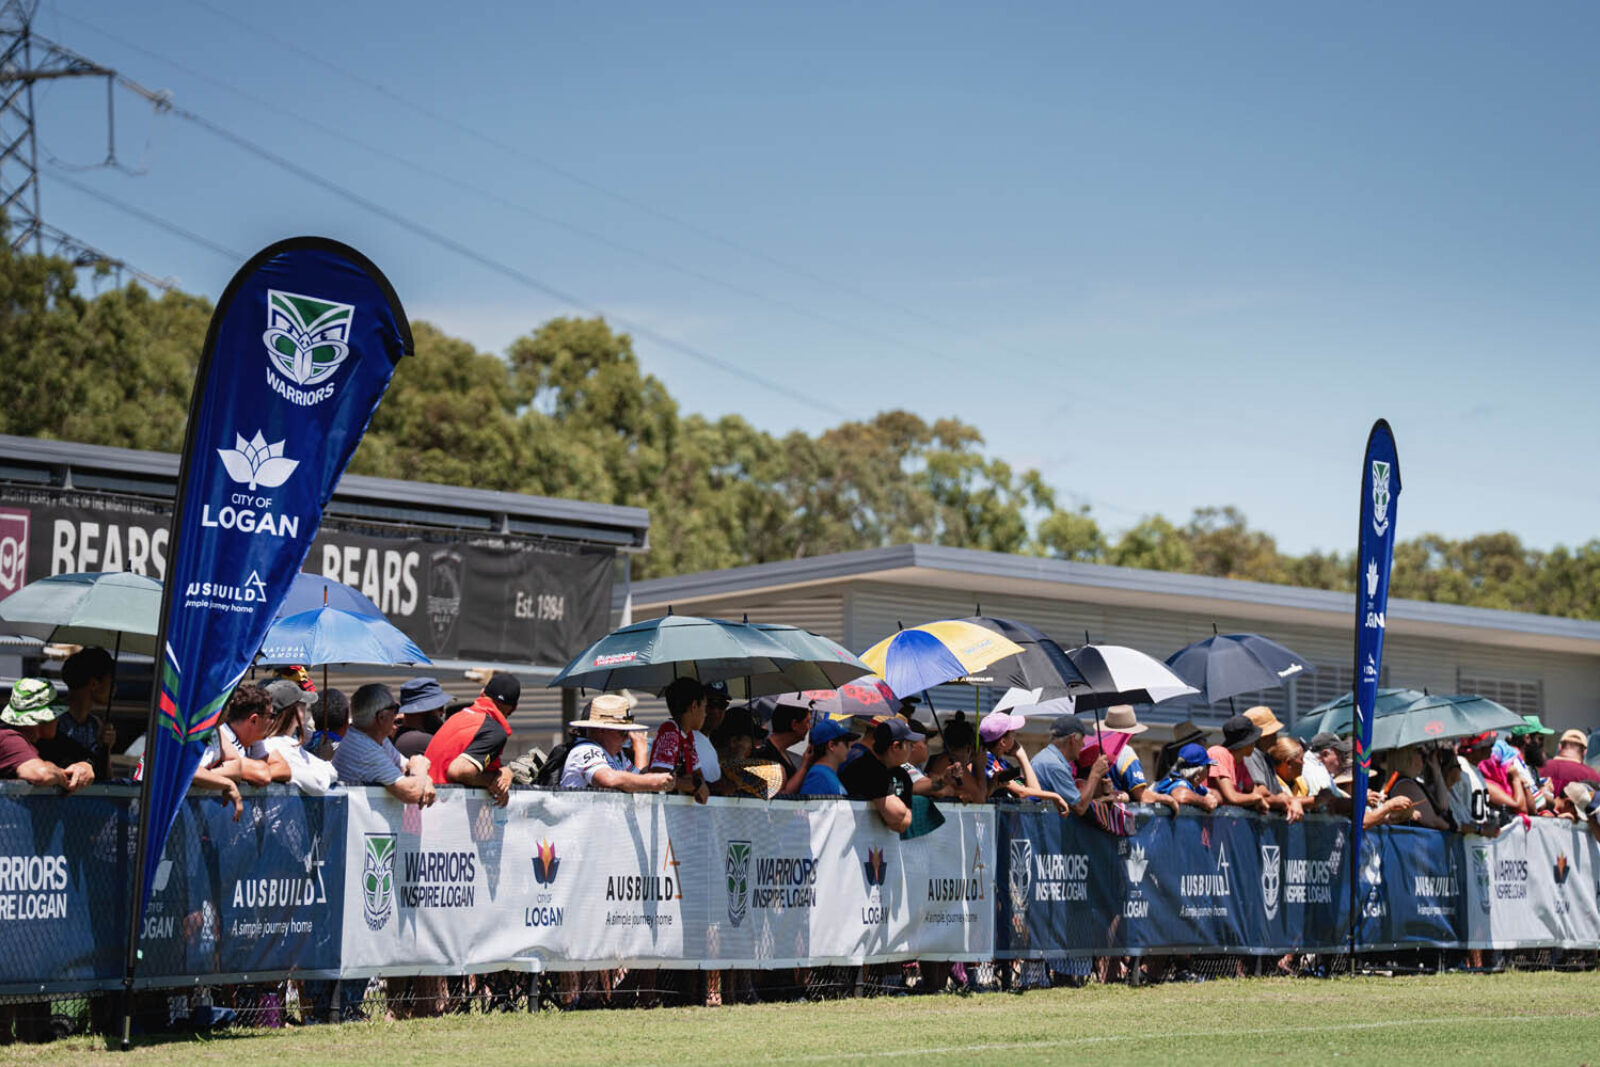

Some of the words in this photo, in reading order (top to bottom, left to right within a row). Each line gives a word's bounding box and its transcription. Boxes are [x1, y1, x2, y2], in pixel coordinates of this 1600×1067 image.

[266, 366, 335, 406] WARRIORS
[231, 493, 254, 506] CITY
[255, 497, 272, 508] OF
[201, 504, 299, 538] LOGAN
[51, 519, 169, 580] BEARS
[322, 544, 420, 616] BEARS
[231, 603, 254, 613] home
[515, 591, 535, 618] Est.
[537, 594, 565, 621] 1984
[404, 852, 476, 882] WARRIORS
[756, 858, 819, 885] WARRIORS
[1034, 854, 1089, 880] WARRIORS
[1284, 859, 1331, 884] WARRIORS
[232, 878, 315, 908] AUSBUILD
[400, 886, 440, 908] INSPIRE
[440, 886, 475, 908] LOGAN
[605, 876, 673, 901] AUSBUILD
[928, 878, 978, 901] AUSBUILD
[1061, 882, 1088, 901] LOGAN
[1180, 874, 1225, 897] AUSBUILD
[1307, 885, 1332, 903] LOGAN
[18, 893, 67, 919] LOGAN
[752, 888, 785, 908] INSPIRE
[787, 888, 817, 908] LOGAN
[1123, 901, 1149, 918] LOGAN
[231, 919, 238, 936] A
[238, 917, 262, 938] simple
[262, 917, 290, 938] journey
[290, 916, 313, 934] home
[525, 906, 564, 927] LOGAN
[862, 906, 890, 925] LOGAN
[140, 916, 175, 939] OGAN
